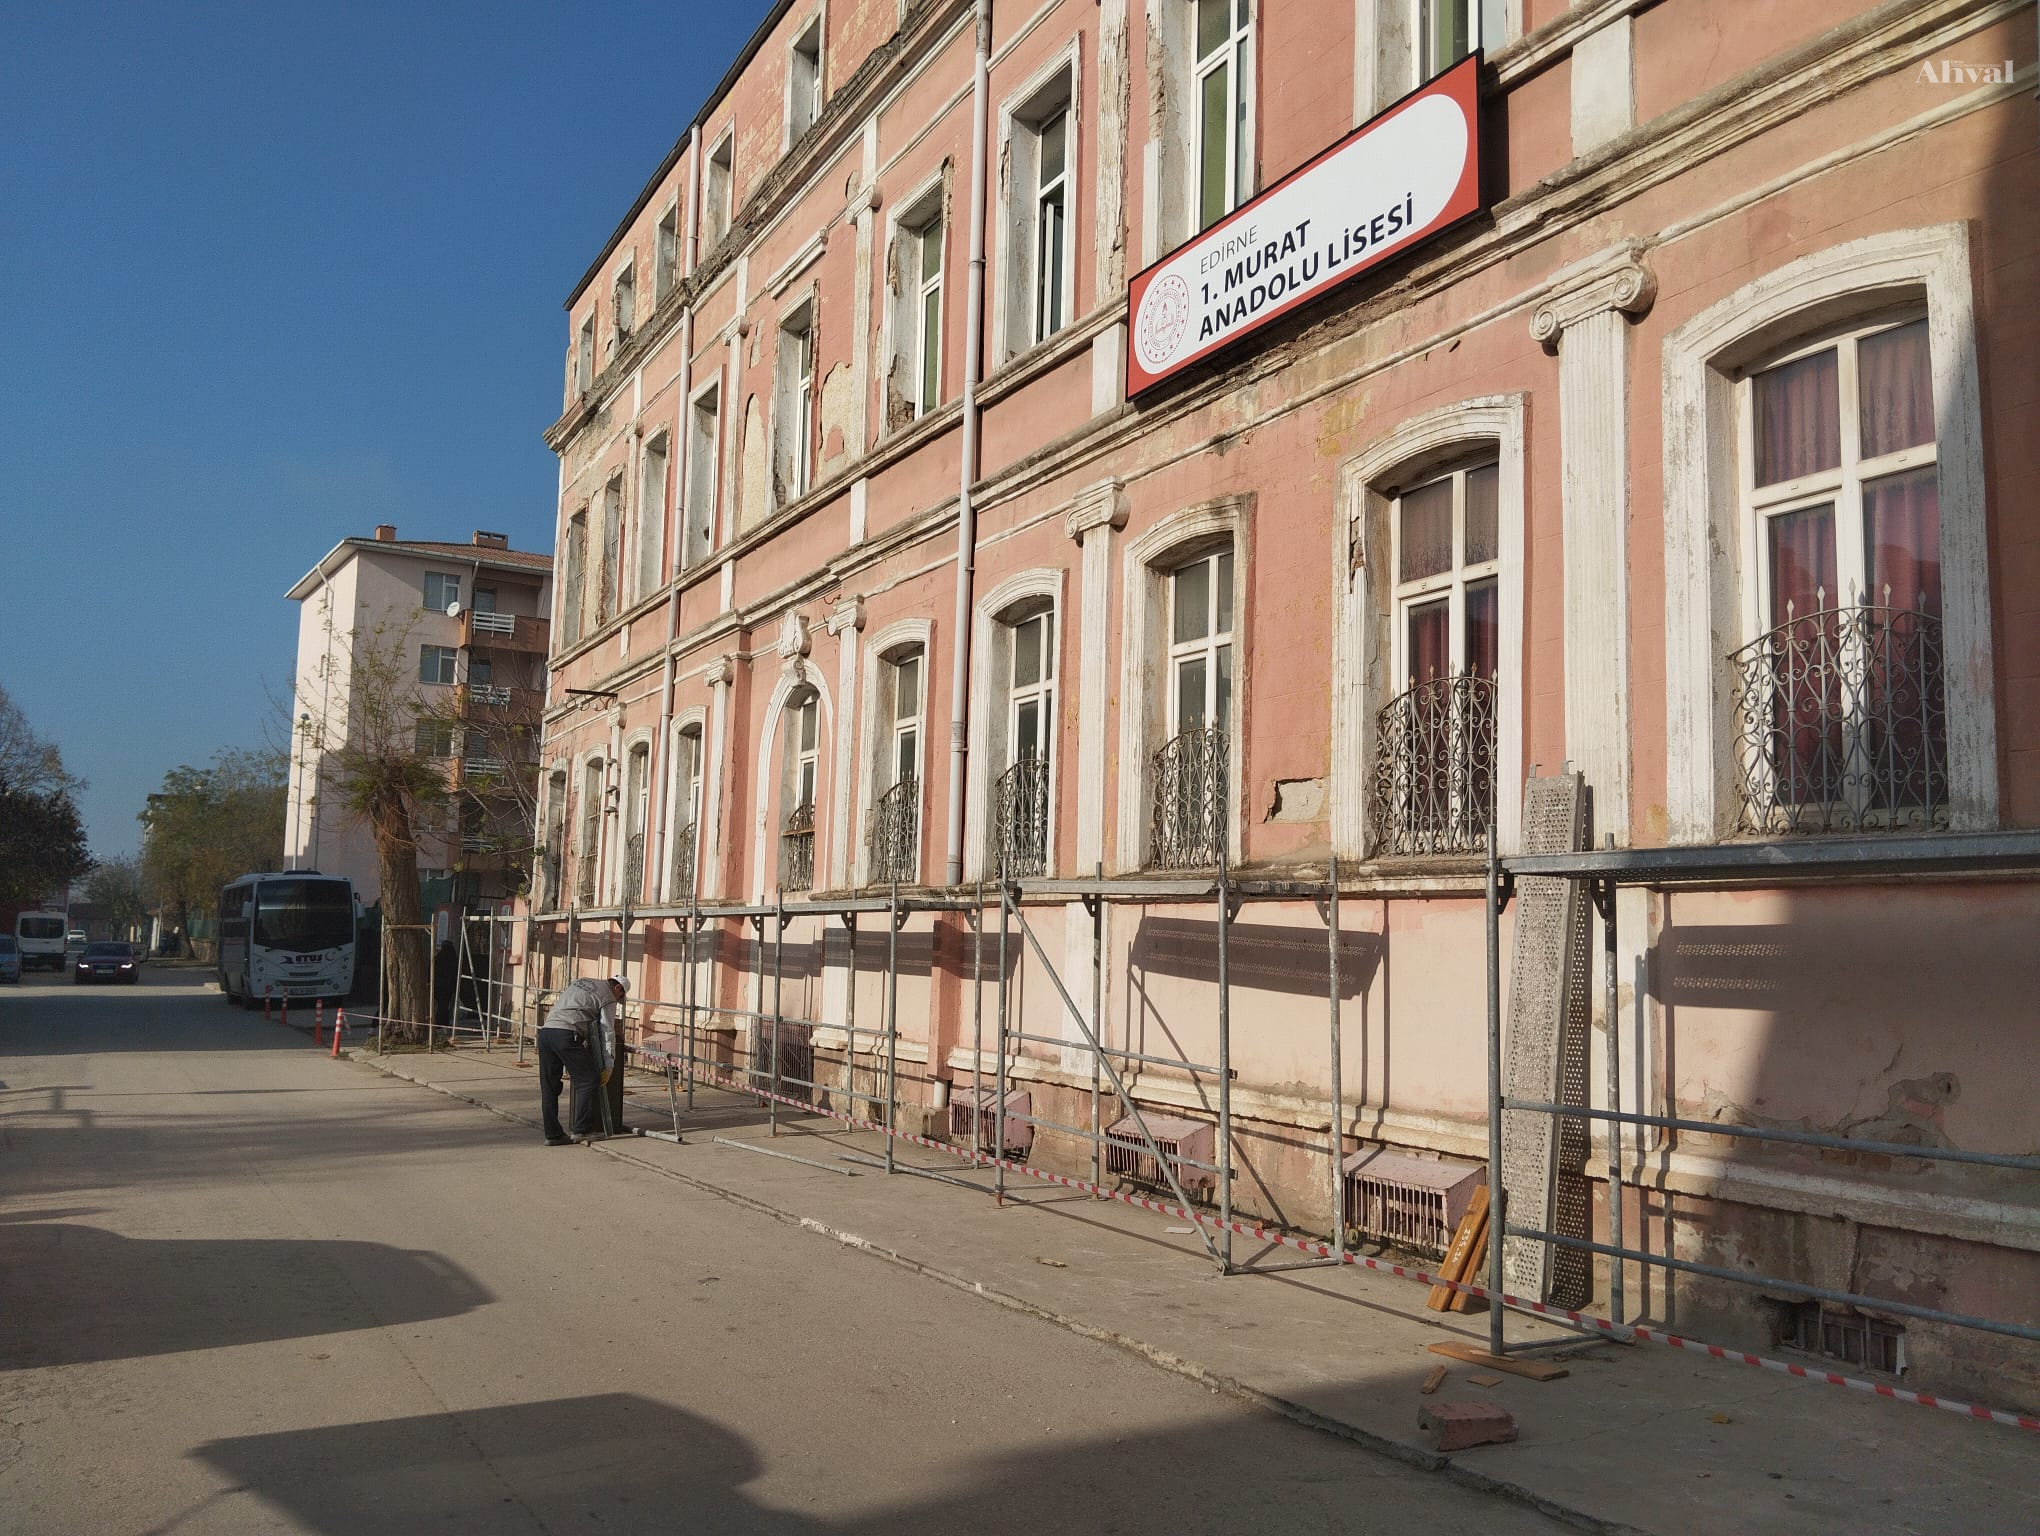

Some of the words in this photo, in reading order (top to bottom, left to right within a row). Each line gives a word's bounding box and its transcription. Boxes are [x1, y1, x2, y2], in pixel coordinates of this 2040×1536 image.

[1199, 251, 1319, 342] ANADOLU
[1328, 192, 1413, 269] LİSESİ
[1200, 225, 1257, 274] EDİRNE
[1201, 282, 1218, 305] 1.
[1224, 219, 1311, 293] MURAT
